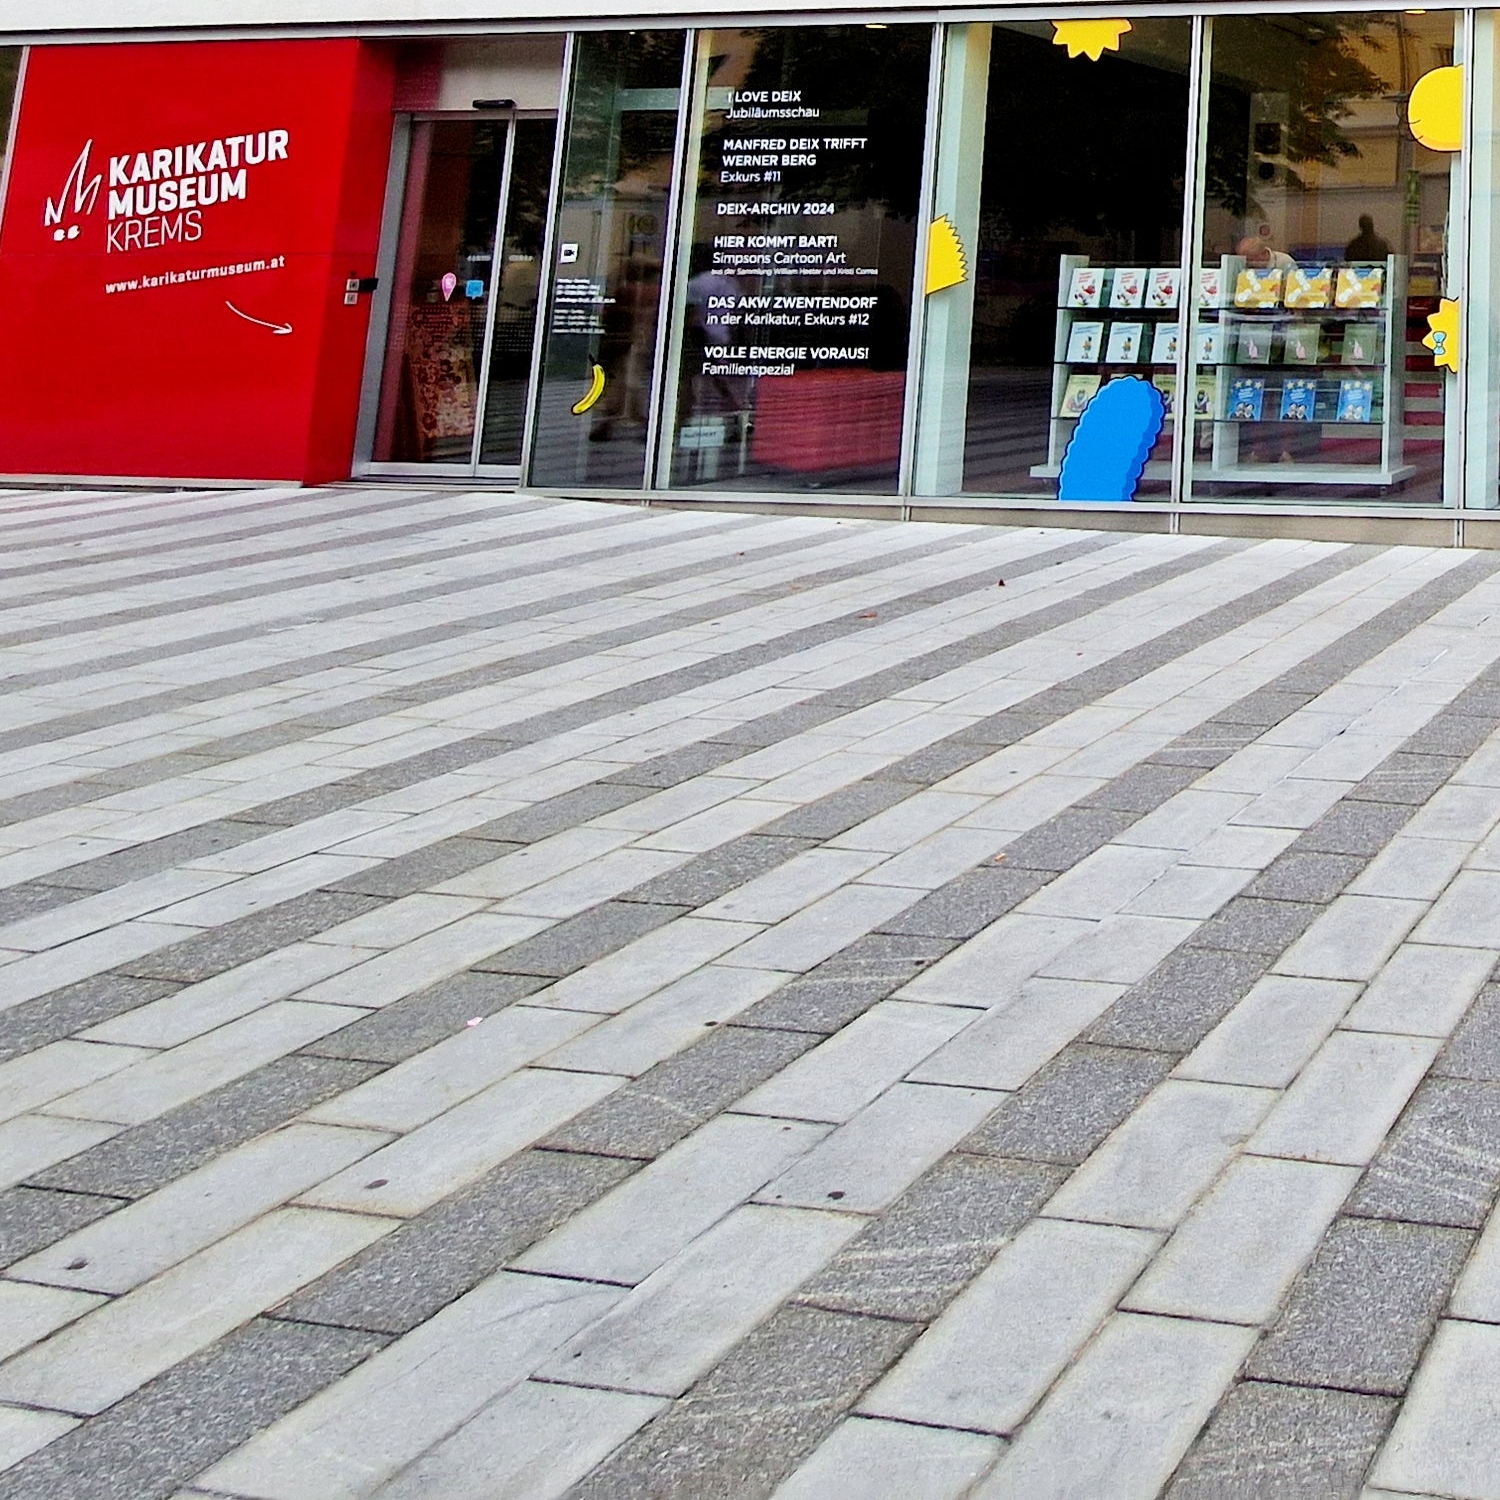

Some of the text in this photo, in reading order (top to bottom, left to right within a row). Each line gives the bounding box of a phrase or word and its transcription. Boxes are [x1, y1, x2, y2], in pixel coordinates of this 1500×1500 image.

[728, 91, 802, 103] I LOVE DEIX
[725, 107, 820, 119] Jubiläumsschau
[723, 138, 868, 151] MANFRED DEIX TRIFFT
[108, 129, 289, 187] KARIKATUR
[722, 155, 817, 167] WERNER BERG
[720, 171, 781, 183] Exkurs #11
[108, 168, 247, 220] MUSEUM
[717, 203, 835, 215] DEIX-ARCHIV 2024
[106, 210, 202, 254] KREMS
[714, 235, 838, 248] HIER KOMMT BART!
[713, 252, 847, 266] Simpsons Cartoon Art
[105, 255, 285, 294] www.karikaturmuseum.at
[708, 296, 878, 309] DAS AKW ZWENTENDORF
[706, 313, 869, 327] in der Karikatur, Exkurs #12
[704, 346, 869, 359] VOLLE ENERGIE VORAUS!
[702, 363, 795, 377] Familienspezial
